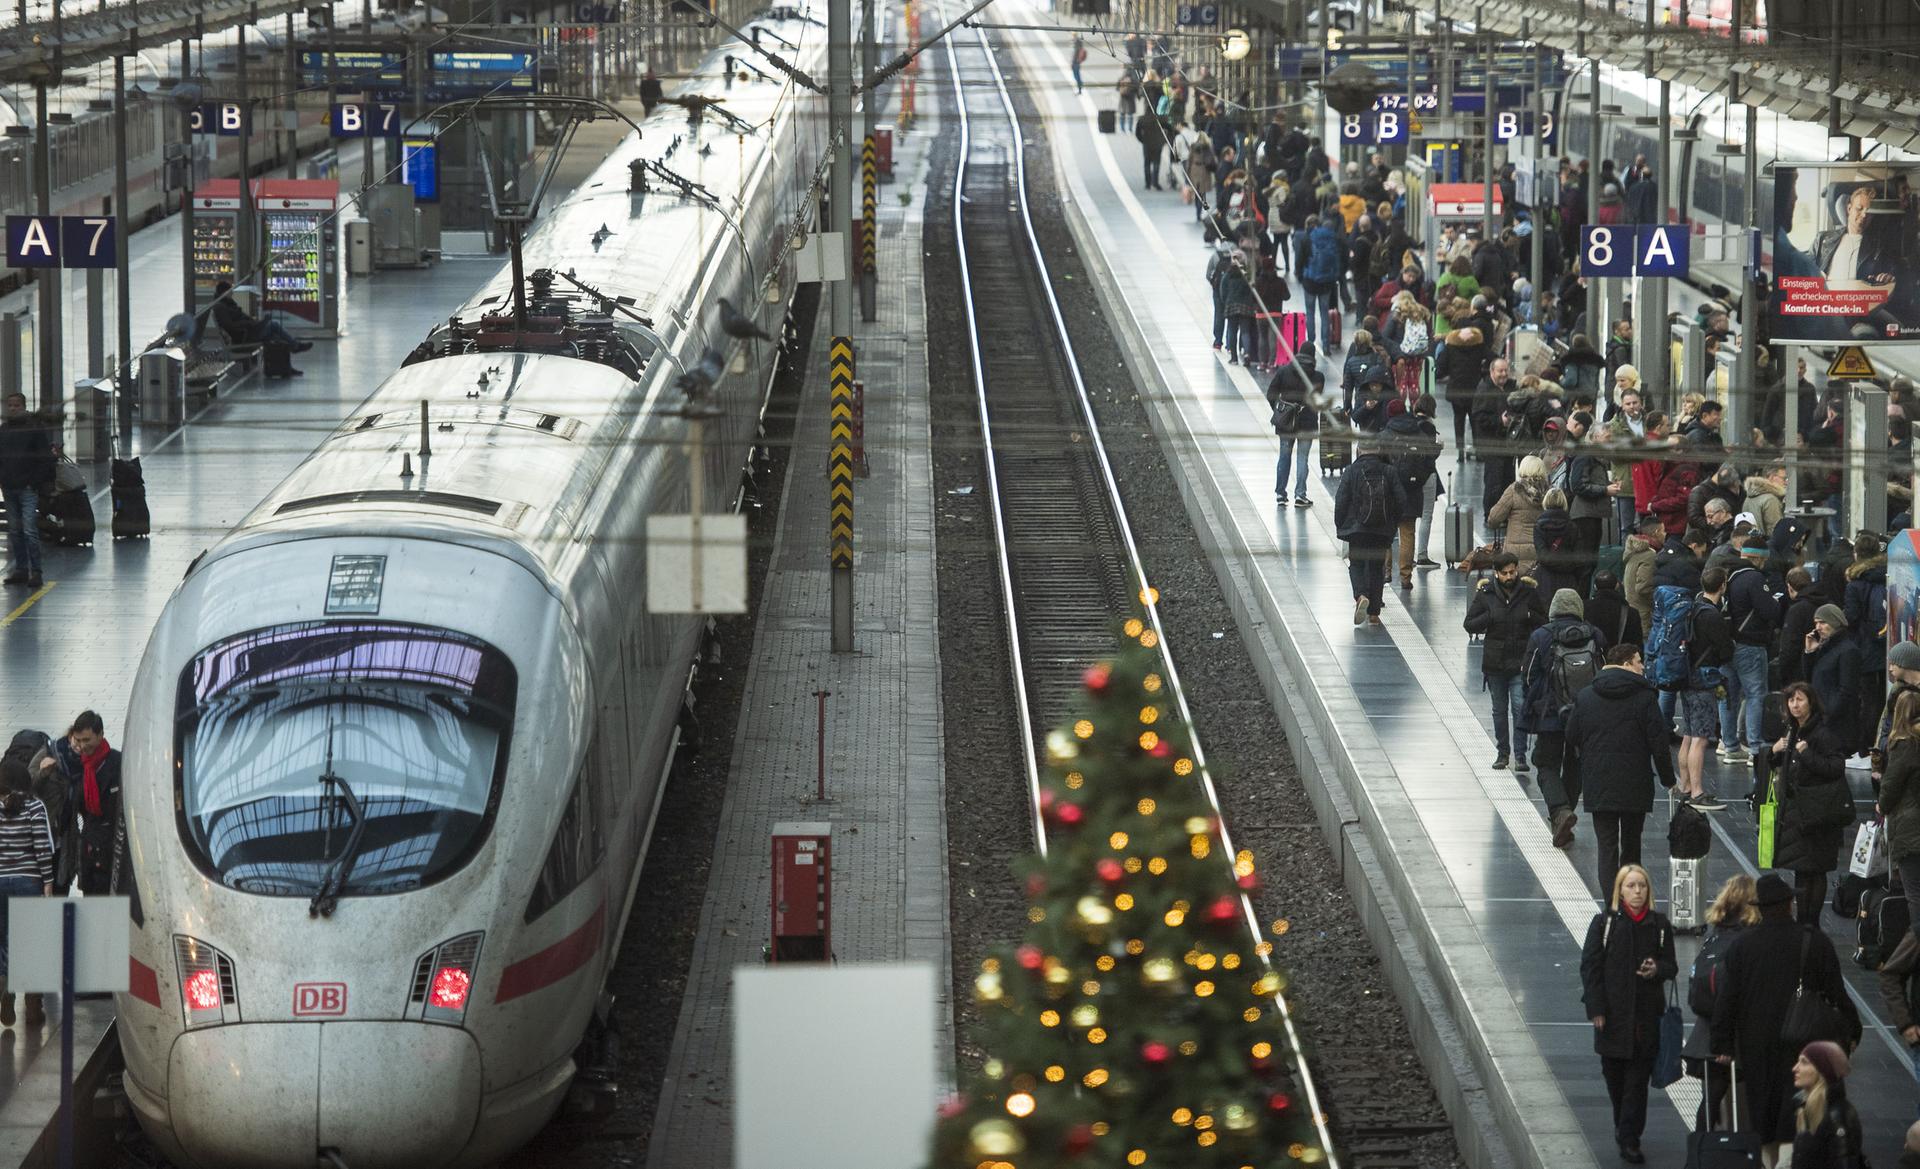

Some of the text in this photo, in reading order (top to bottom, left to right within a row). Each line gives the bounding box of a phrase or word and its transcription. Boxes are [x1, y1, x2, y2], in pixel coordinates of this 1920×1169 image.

[579, 5, 613, 20] C 7
[1201, 5, 1215, 23] C
[222, 103, 241, 129] B
[342, 104, 395, 130] B 7
[1344, 112, 1399, 138] 8 B
[1498, 112, 1517, 138] B
[20, 218, 108, 256] A 7
[1588, 227, 1675, 266] 8 A
[1782, 278, 1819, 289] Einsteigen,
[1791, 291, 1834, 301] einchecken,
[1785, 303, 1865, 313] Komfort Check-in.
[300, 987, 340, 1011] DB
